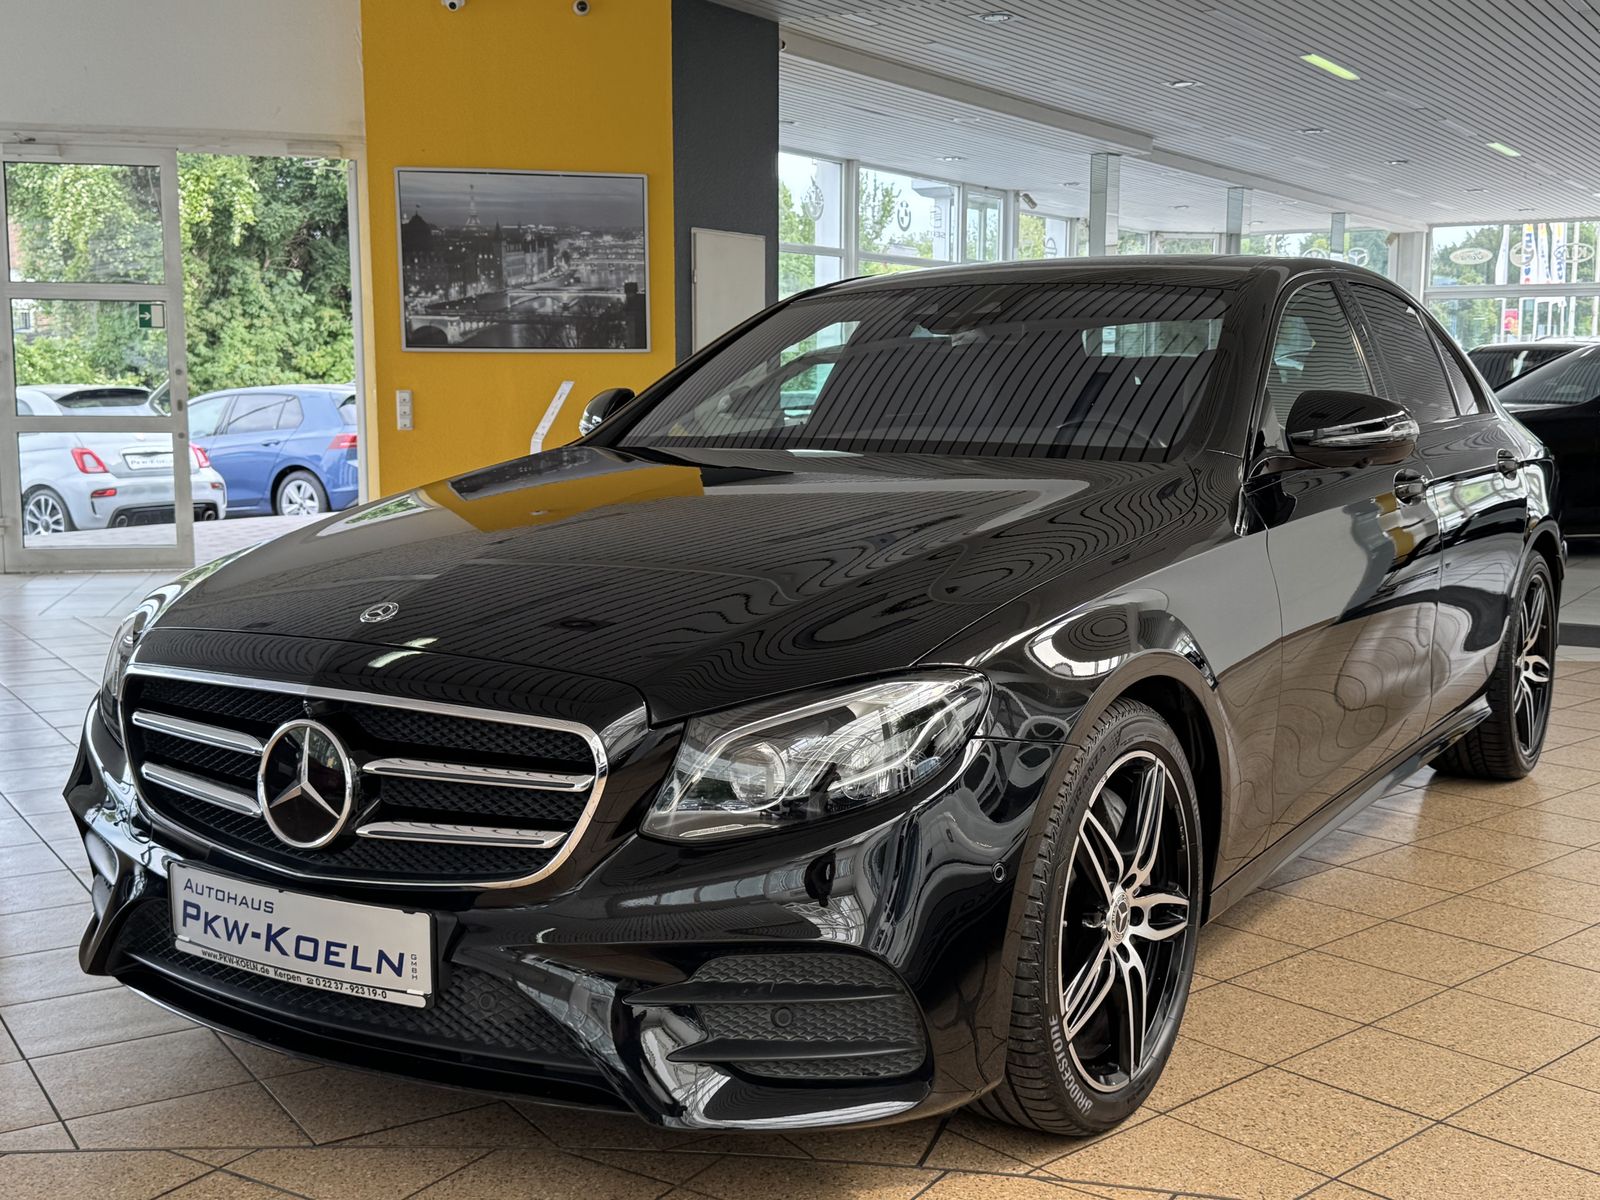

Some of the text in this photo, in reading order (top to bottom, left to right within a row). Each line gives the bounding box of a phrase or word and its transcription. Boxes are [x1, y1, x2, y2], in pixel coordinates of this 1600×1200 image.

[183, 878, 274, 914] AUTOHAUS
[182, 900, 405, 977] PKW-KOELN
[201, 949, 270, 975] www.PKW-KOELN.de
[274, 968, 302, 983] Kerpen
[1049, 1013, 1093, 1115] BRIDGESTONE
